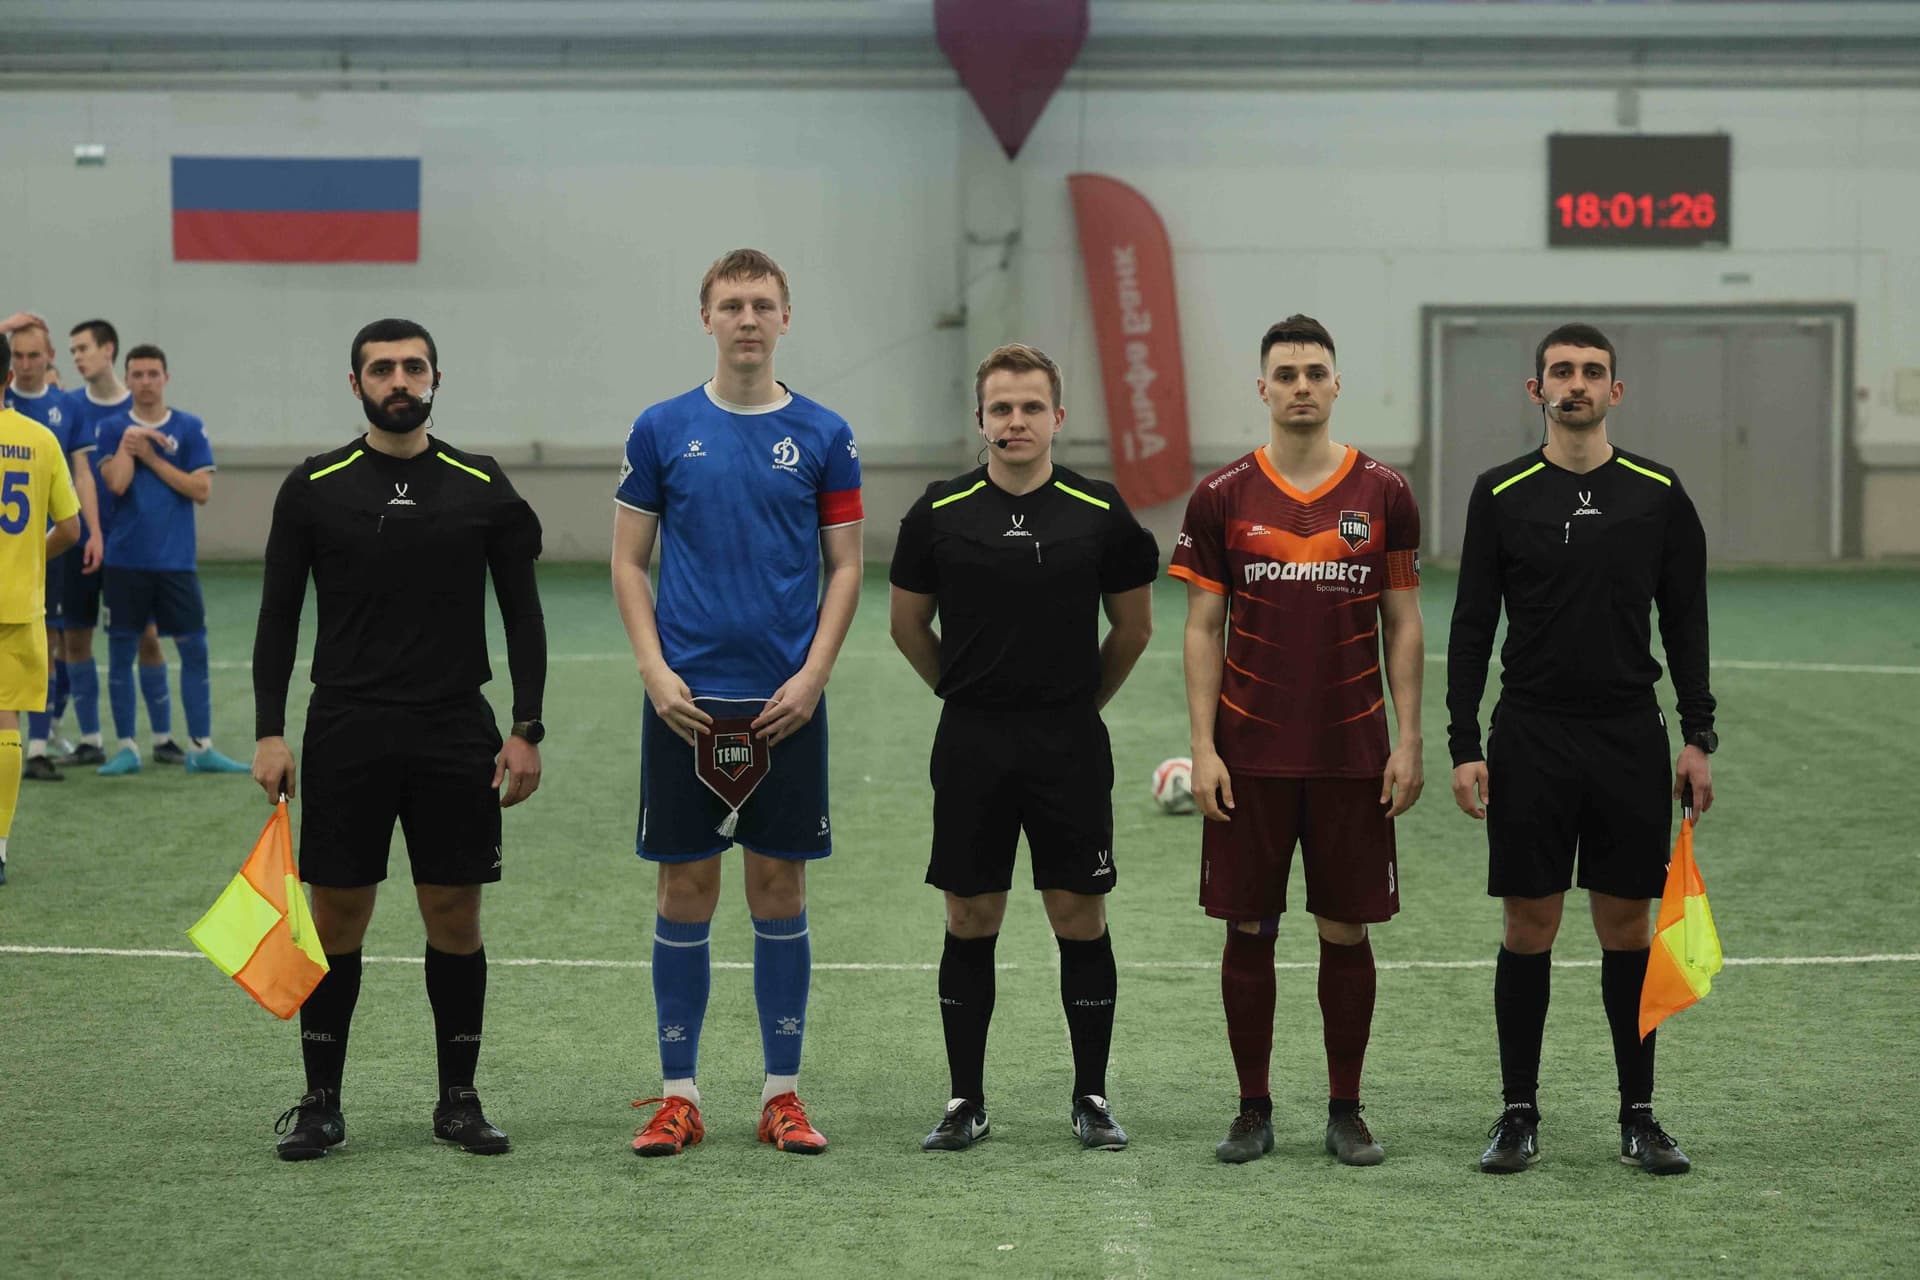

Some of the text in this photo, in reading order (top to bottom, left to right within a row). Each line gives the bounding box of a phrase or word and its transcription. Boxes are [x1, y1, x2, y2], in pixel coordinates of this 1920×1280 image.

[1341, 521, 1367, 539] ТЕМП
[1244, 561, 1372, 585] ПРОДИНВЕСТ
[717, 746, 749, 764] ТЕМП
